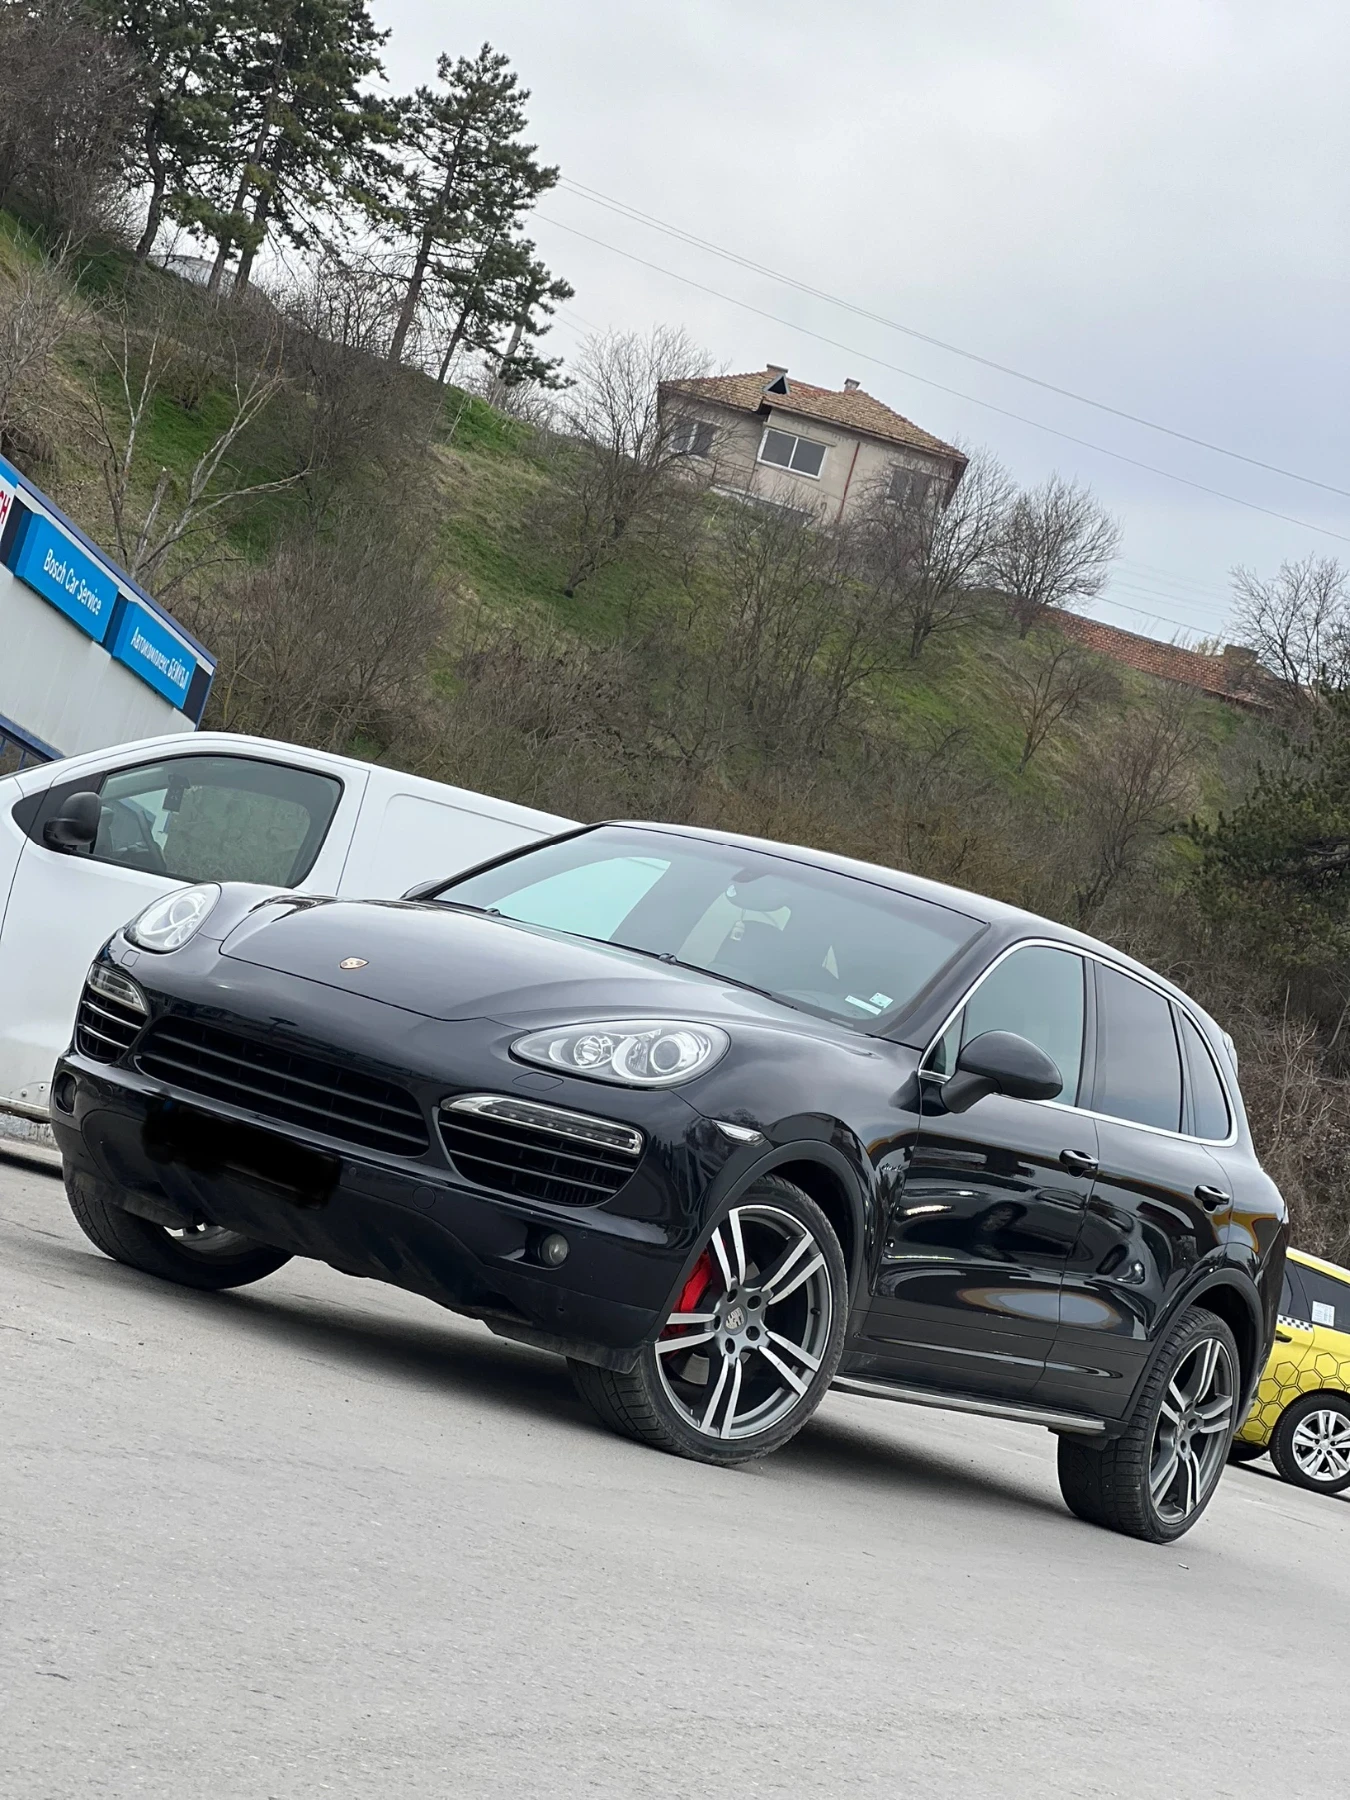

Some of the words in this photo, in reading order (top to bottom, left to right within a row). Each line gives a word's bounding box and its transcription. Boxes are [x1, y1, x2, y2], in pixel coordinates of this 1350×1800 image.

[43, 548, 67, 585] Bosch
[65, 567, 80, 595] Car
[76, 578, 102, 616] Service
